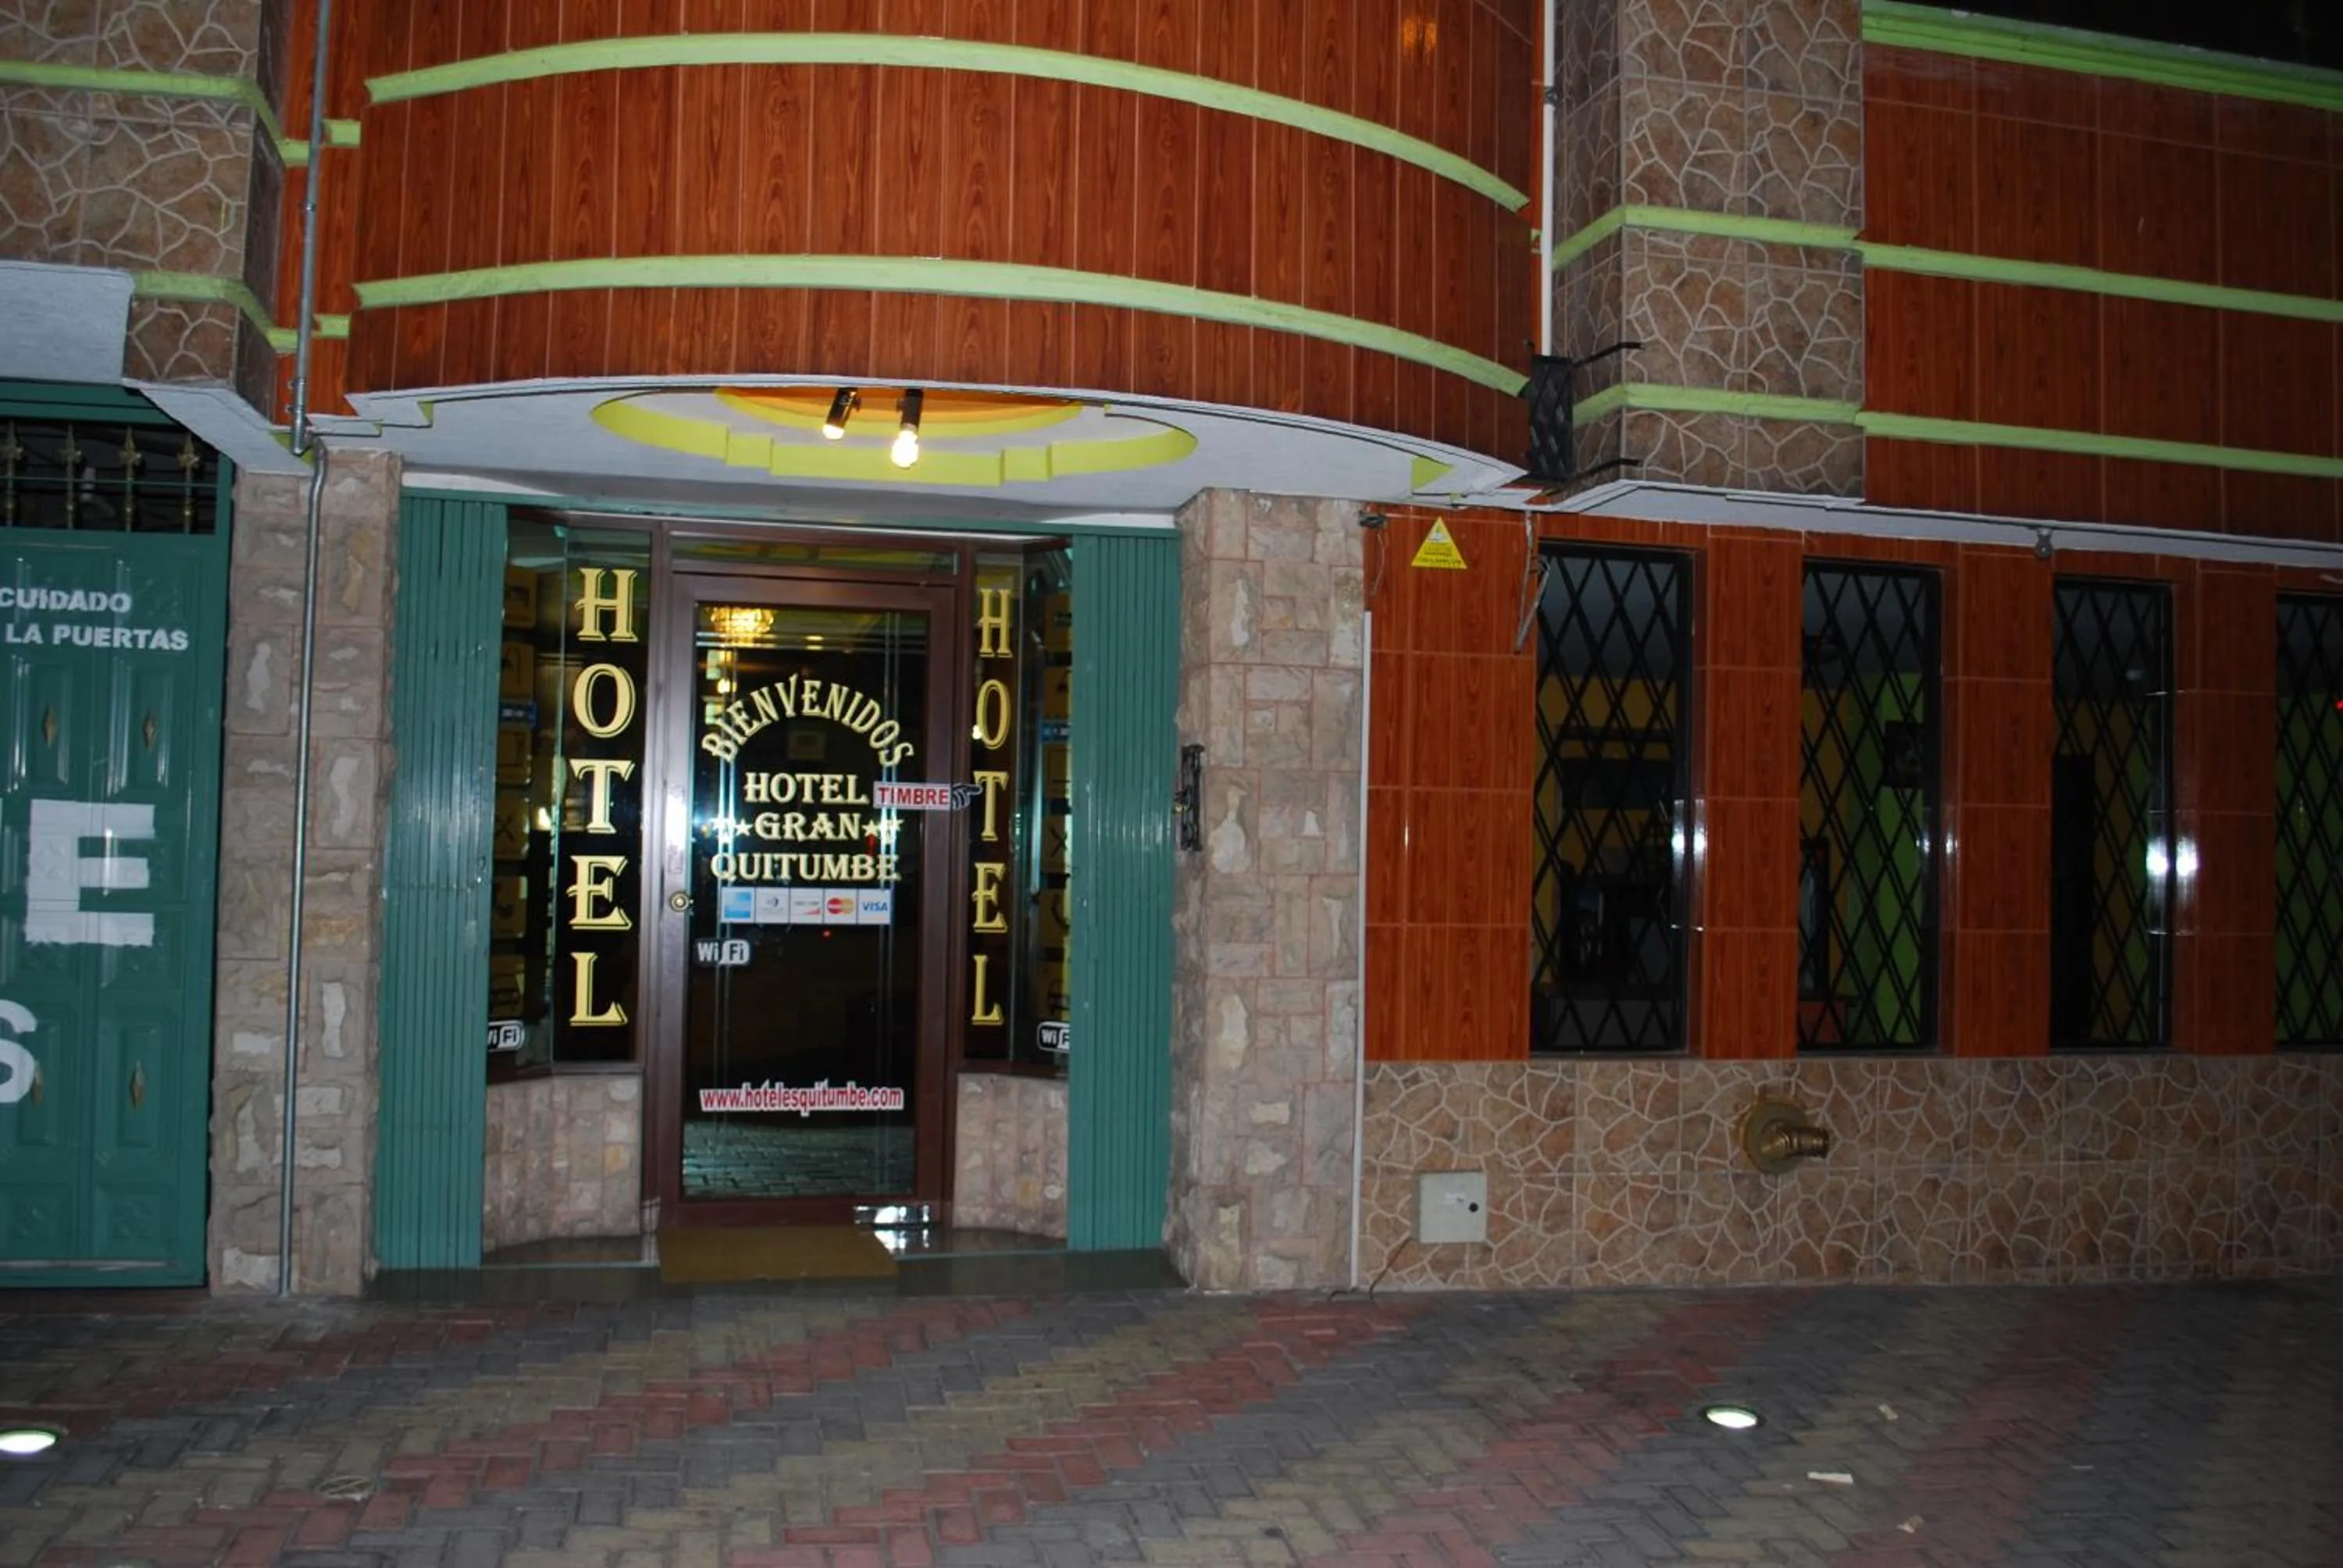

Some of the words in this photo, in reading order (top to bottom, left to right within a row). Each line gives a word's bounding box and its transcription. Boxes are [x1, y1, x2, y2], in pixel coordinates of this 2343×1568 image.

[0, 587, 132, 613] CUIDADO
[5, 623, 44, 644] LA
[52, 625, 189, 651] PUERTAS
[702, 673, 915, 767] BIENVENIDOS
[567, 568, 638, 1026] HOTEL
[744, 772, 868, 804] HOTEL
[877, 786, 949, 806] TIMBRE
[972, 587, 1013, 1027] HOTEL
[754, 812, 861, 843] GRAN
[710, 853, 901, 882] QUITUMBE
[861, 901, 888, 912] VISA
[701, 1079, 904, 1117] www.hotelesquitumbe.com
